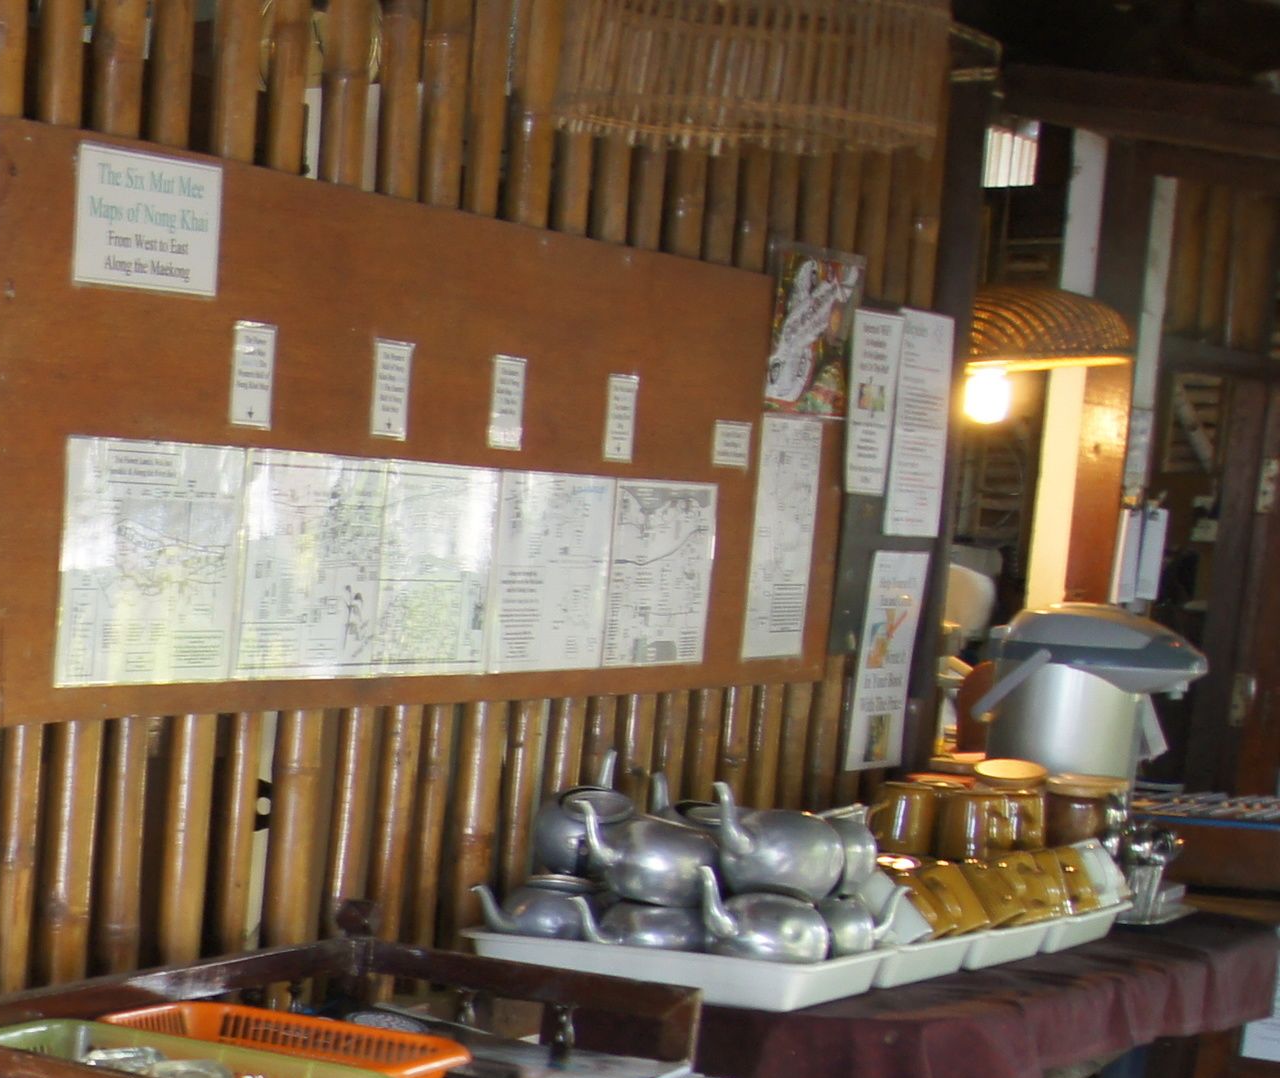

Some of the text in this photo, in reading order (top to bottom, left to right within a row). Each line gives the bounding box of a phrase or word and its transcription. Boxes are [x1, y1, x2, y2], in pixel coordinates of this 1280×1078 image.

[98, 163, 205, 199] The Six Mut Mee
[89, 196, 208, 233] Maps of Nong Khai
[106, 231, 189, 255] From West to East
[104, 255, 132, 276] Along
[134, 259, 149, 273] the
